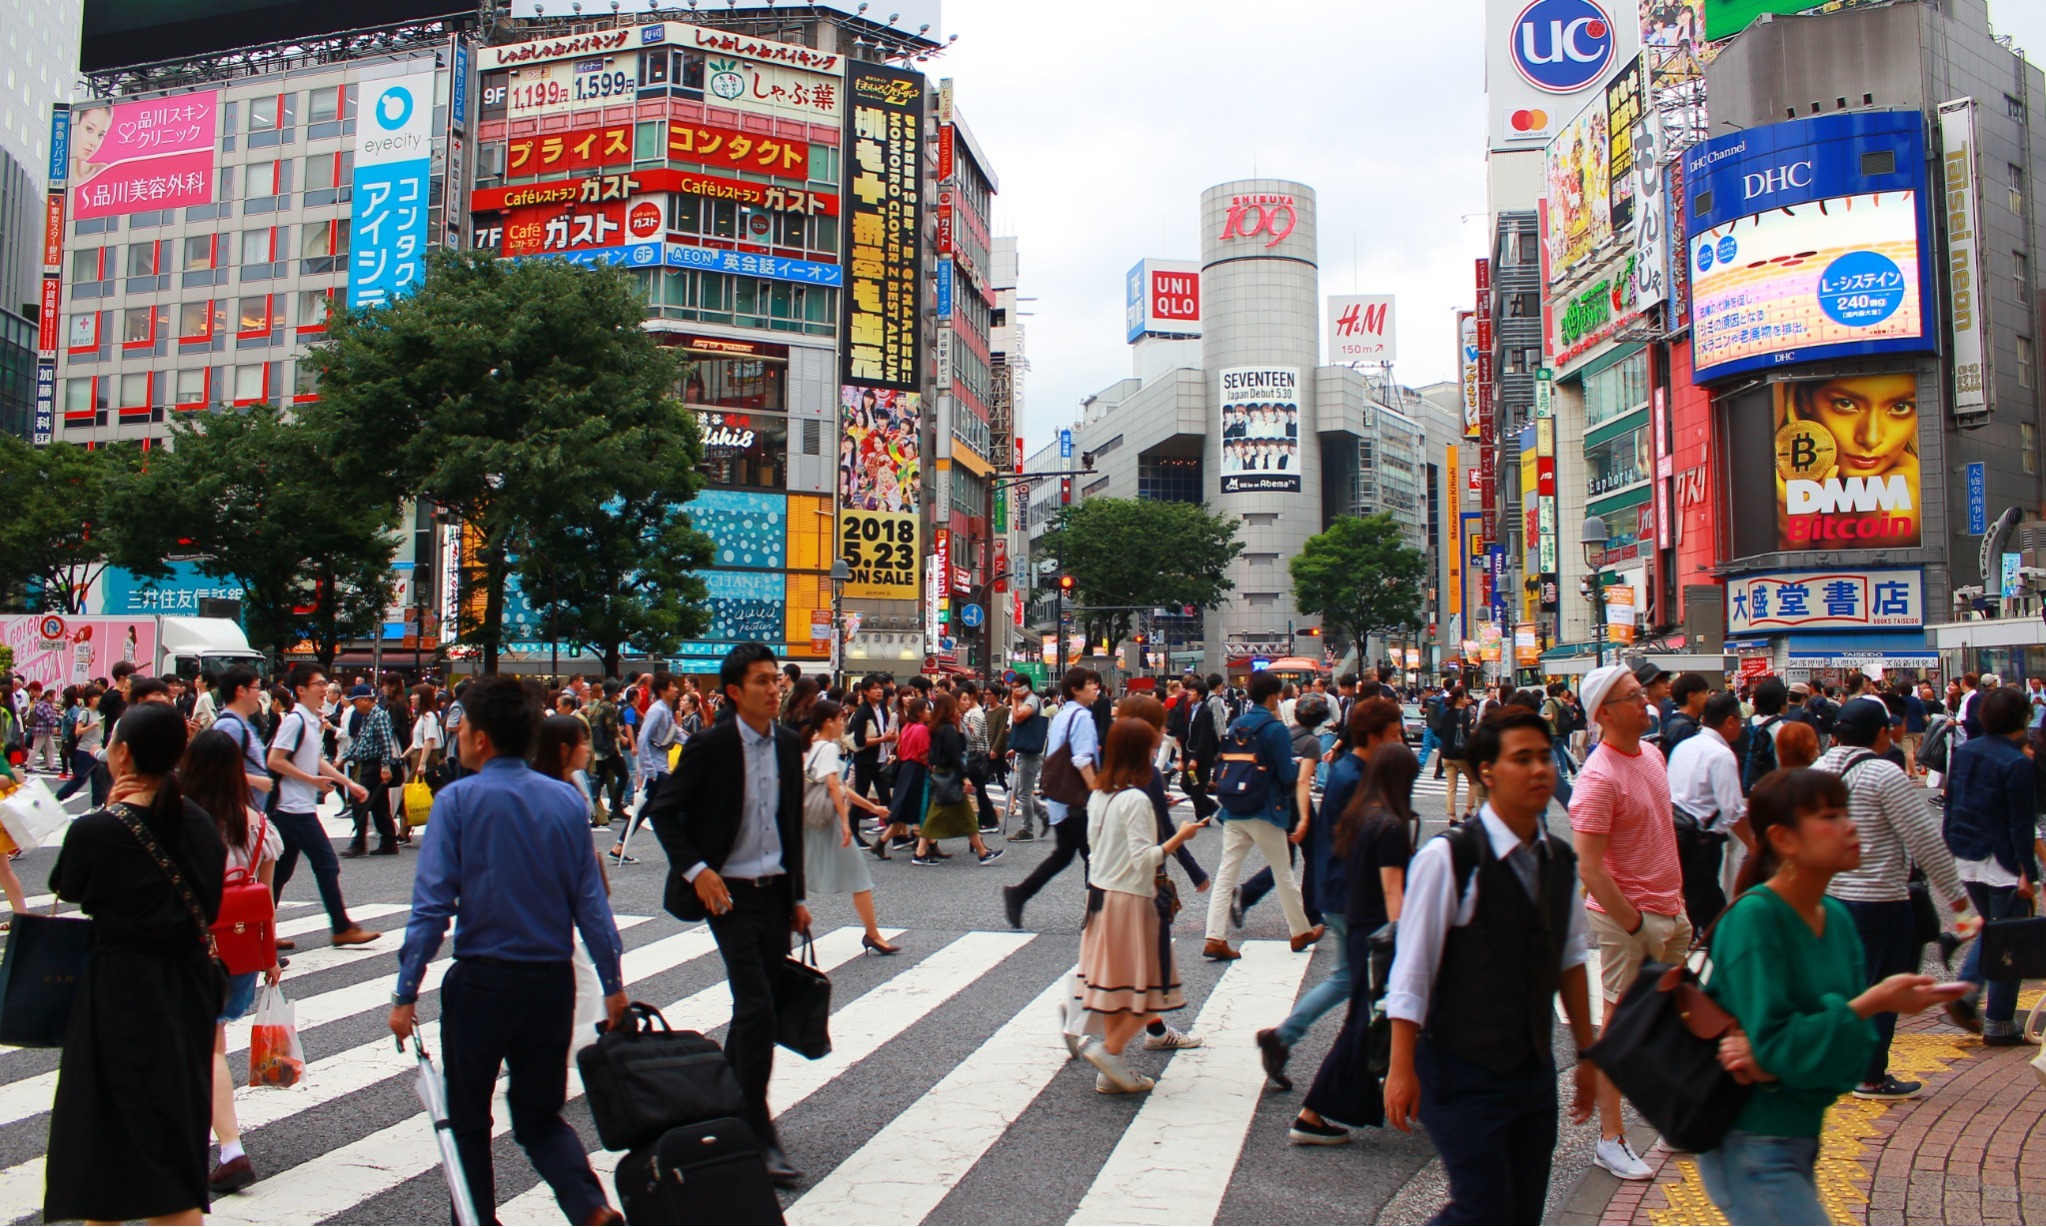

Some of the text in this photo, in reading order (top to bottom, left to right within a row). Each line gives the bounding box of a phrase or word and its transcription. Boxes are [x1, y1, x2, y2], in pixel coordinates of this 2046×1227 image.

[496, 30, 628, 64] しゃぶしゃぶバイキング
[643, 26, 662, 42] 寿司
[696, 29, 837, 70] しゃぶしゃぶバイキング
[484, 87, 506, 104] 9F
[513, 81, 568, 112] 1,199円
[575, 71, 634, 103] 1,599円
[754, 72, 834, 110] しゃぶ葉
[138, 104, 210, 128] 品川スキン
[53, 121, 65, 176] 東急リバブル
[138, 124, 201, 149] クリニック
[365, 133, 422, 156] eyecity
[510, 129, 628, 168] プライス
[670, 126, 802, 169] コンタクト
[1690, 141, 1746, 172] DHC Channel
[94, 171, 205, 208] 品川美容外科
[580, 174, 640, 204] ガスト
[1743, 160, 1812, 200] DHC
[764, 186, 825, 216] ガスト
[1232, 196, 1294, 205] SHIBUYA
[1634, 121, 1661, 298] もんじゃ
[48, 207, 60, 264] 東京スター銀行
[476, 228, 502, 248] 7F
[510, 222, 541, 240] Café
[544, 212, 618, 250] ガスト
[633, 218, 658, 228] ガスト
[941, 218, 950, 247] ガスト
[1218, 204, 1297, 248] 109
[1946, 140, 1972, 333] Taisei neon
[394, 178, 418, 301] コンタク
[510, 238, 540, 250] レストラン
[886, 112, 902, 382] MOMOIRO CLOVER Z BEST ALBUM
[636, 250, 652, 262] 6F
[672, 248, 838, 282] AEON 英会話イーオン
[1157, 276, 1191, 295] UNI
[1822, 272, 1901, 292] L-システイン
[45, 281, 56, 318] 外貨両替
[1157, 296, 1194, 316] QLO
[1837, 295, 1887, 310] 240mg
[1336, 303, 1387, 337] H&M
[1701, 310, 1764, 337] シミの原因となる
[1342, 346, 1372, 354] 150m
[1774, 352, 1796, 362] DHC
[1224, 372, 1295, 389] SEVENTEEN
[1227, 388, 1292, 402] Japan Debut 5.30
[36, 368, 53, 430] 加藤眼科
[36, 434, 50, 442] 5F
[1588, 467, 1634, 494] Euphoria
[1786, 475, 1912, 515] DMM
[1970, 467, 1982, 532] 大盛堂商事ビル
[843, 516, 914, 543] 2018
[1450, 496, 1458, 540] Matsumoto
[1788, 512, 1912, 541] Bitcoin
[843, 542, 914, 570] 5.23
[846, 569, 914, 586] ON SALE
[1733, 580, 1910, 622] 大盛堂書店
